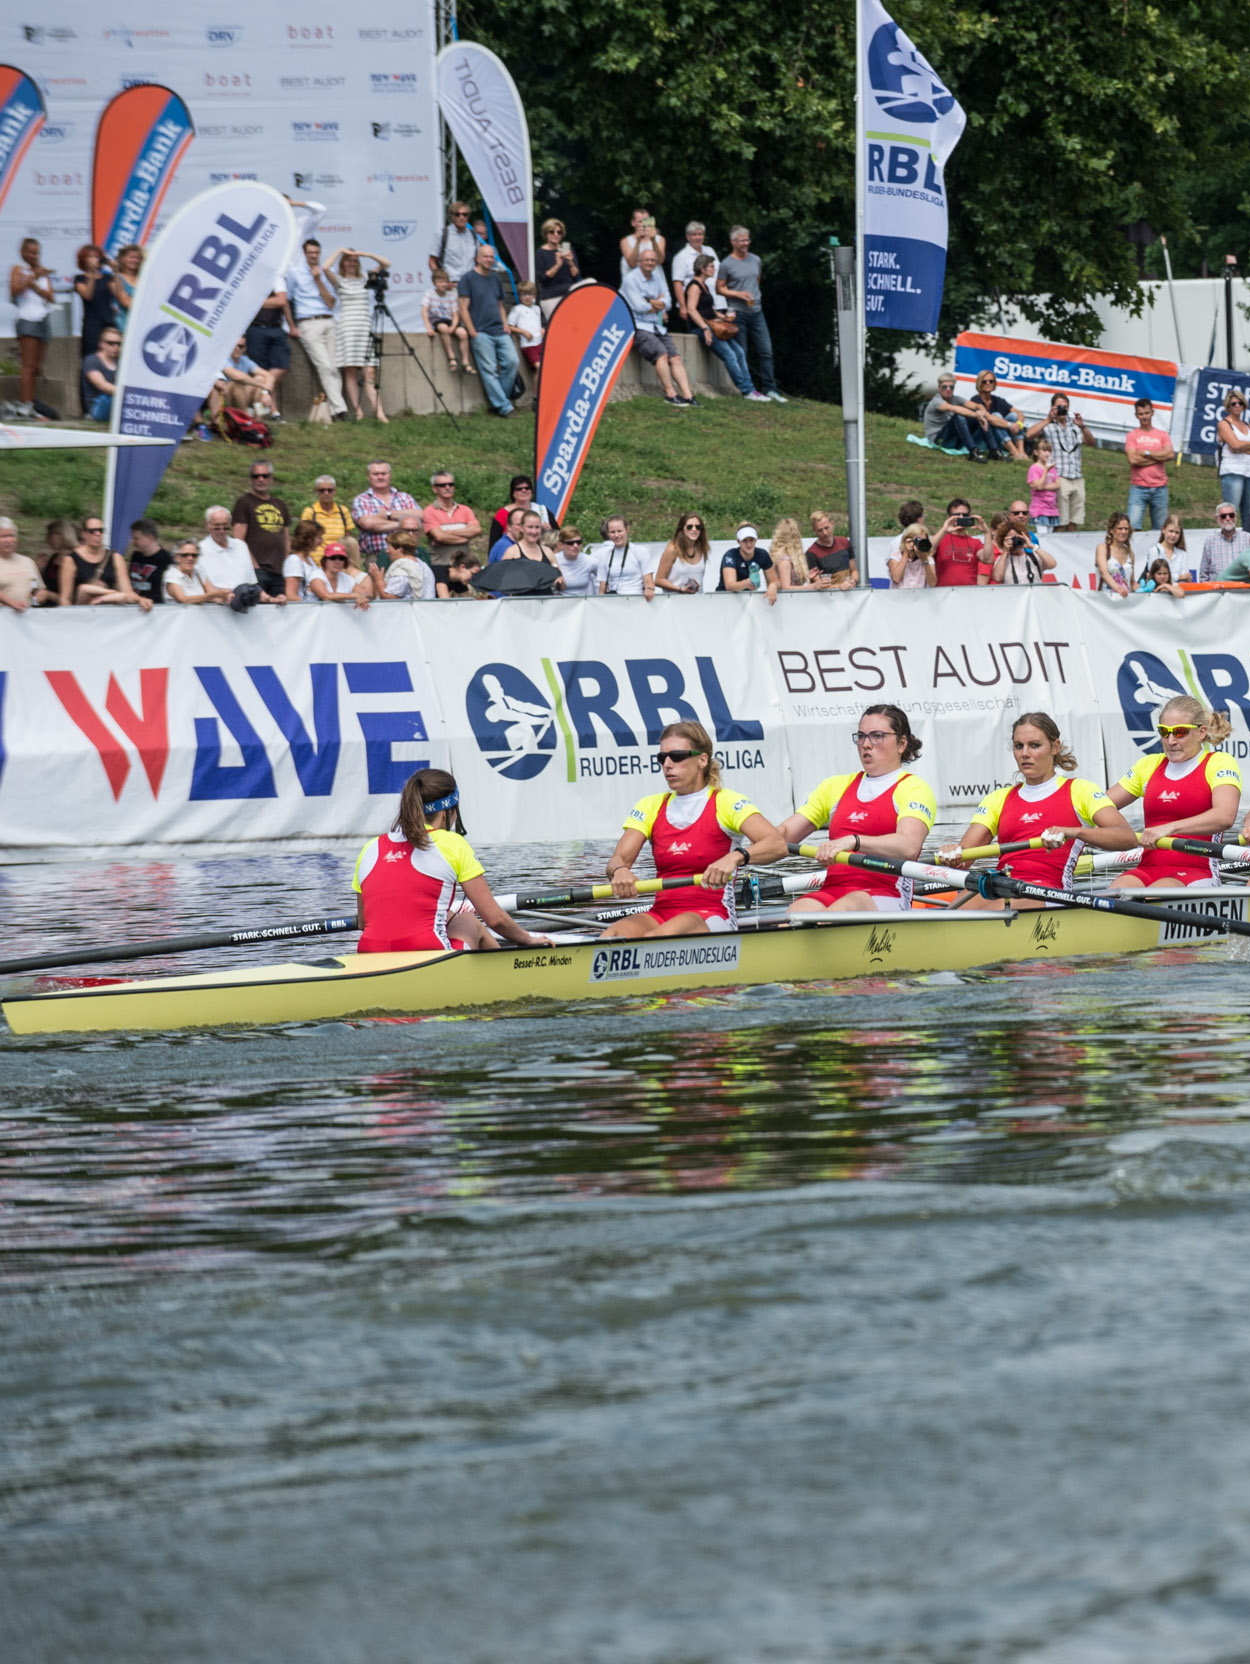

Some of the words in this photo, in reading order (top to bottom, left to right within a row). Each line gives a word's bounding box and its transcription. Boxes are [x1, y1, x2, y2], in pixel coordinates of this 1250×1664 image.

[288, 26, 335, 39] boat
[358, 30, 388, 39] BEST
[391, 29, 424, 39] AUDIT
[205, 73, 252, 87] boat
[279, 77, 309, 87] BEST
[312, 77, 346, 87] AUDIT
[198, 126, 227, 136] BEST
[231, 125, 264, 135] AUDIT
[35, 171, 84, 186] boat
[868, 143, 943, 196] RBL
[382, 224, 409, 236] DRV
[167, 213, 268, 323] RBL
[868, 251, 901, 270] STARK.
[206, 223, 280, 330] RUDER-BUNDESLIGA
[392, 272, 424, 284] oat
[867, 273, 922, 294] SCHNELL.
[993, 356, 1137, 394] Sparda-Bank
[125, 393, 171, 410] STARK.
[542, 323, 626, 496] Sparda-Bank
[124, 408, 185, 426] SCHNELL.
[122, 423, 153, 437] GUT.
[777, 645, 908, 694] BEST
[932, 641, 1070, 688] AUDIT
[556, 656, 765, 749] RBL
[44, 661, 431, 803] WAVE
[425, 804, 436, 812] NK
[442, 800, 451, 808] NK
[1025, 885, 1046, 897] STARK.
[1047, 889, 1075, 903] SCHNELL.
[1076, 894, 1091, 904] GUT.
[597, 911, 624, 921] STARK.
[1164, 898, 1244, 940] MINDEN
[233, 930, 262, 942] STARK.
[262, 926, 301, 938] SCHNELL.
[302, 923, 322, 933] GUT.
[331, 919, 347, 929] RBL
[513, 957, 547, 969] Bessel-R.C.
[548, 955, 572, 966] Minden
[609, 948, 641, 972] RBL
[643, 945, 737, 970] RUDER-BUNDESLIGA
